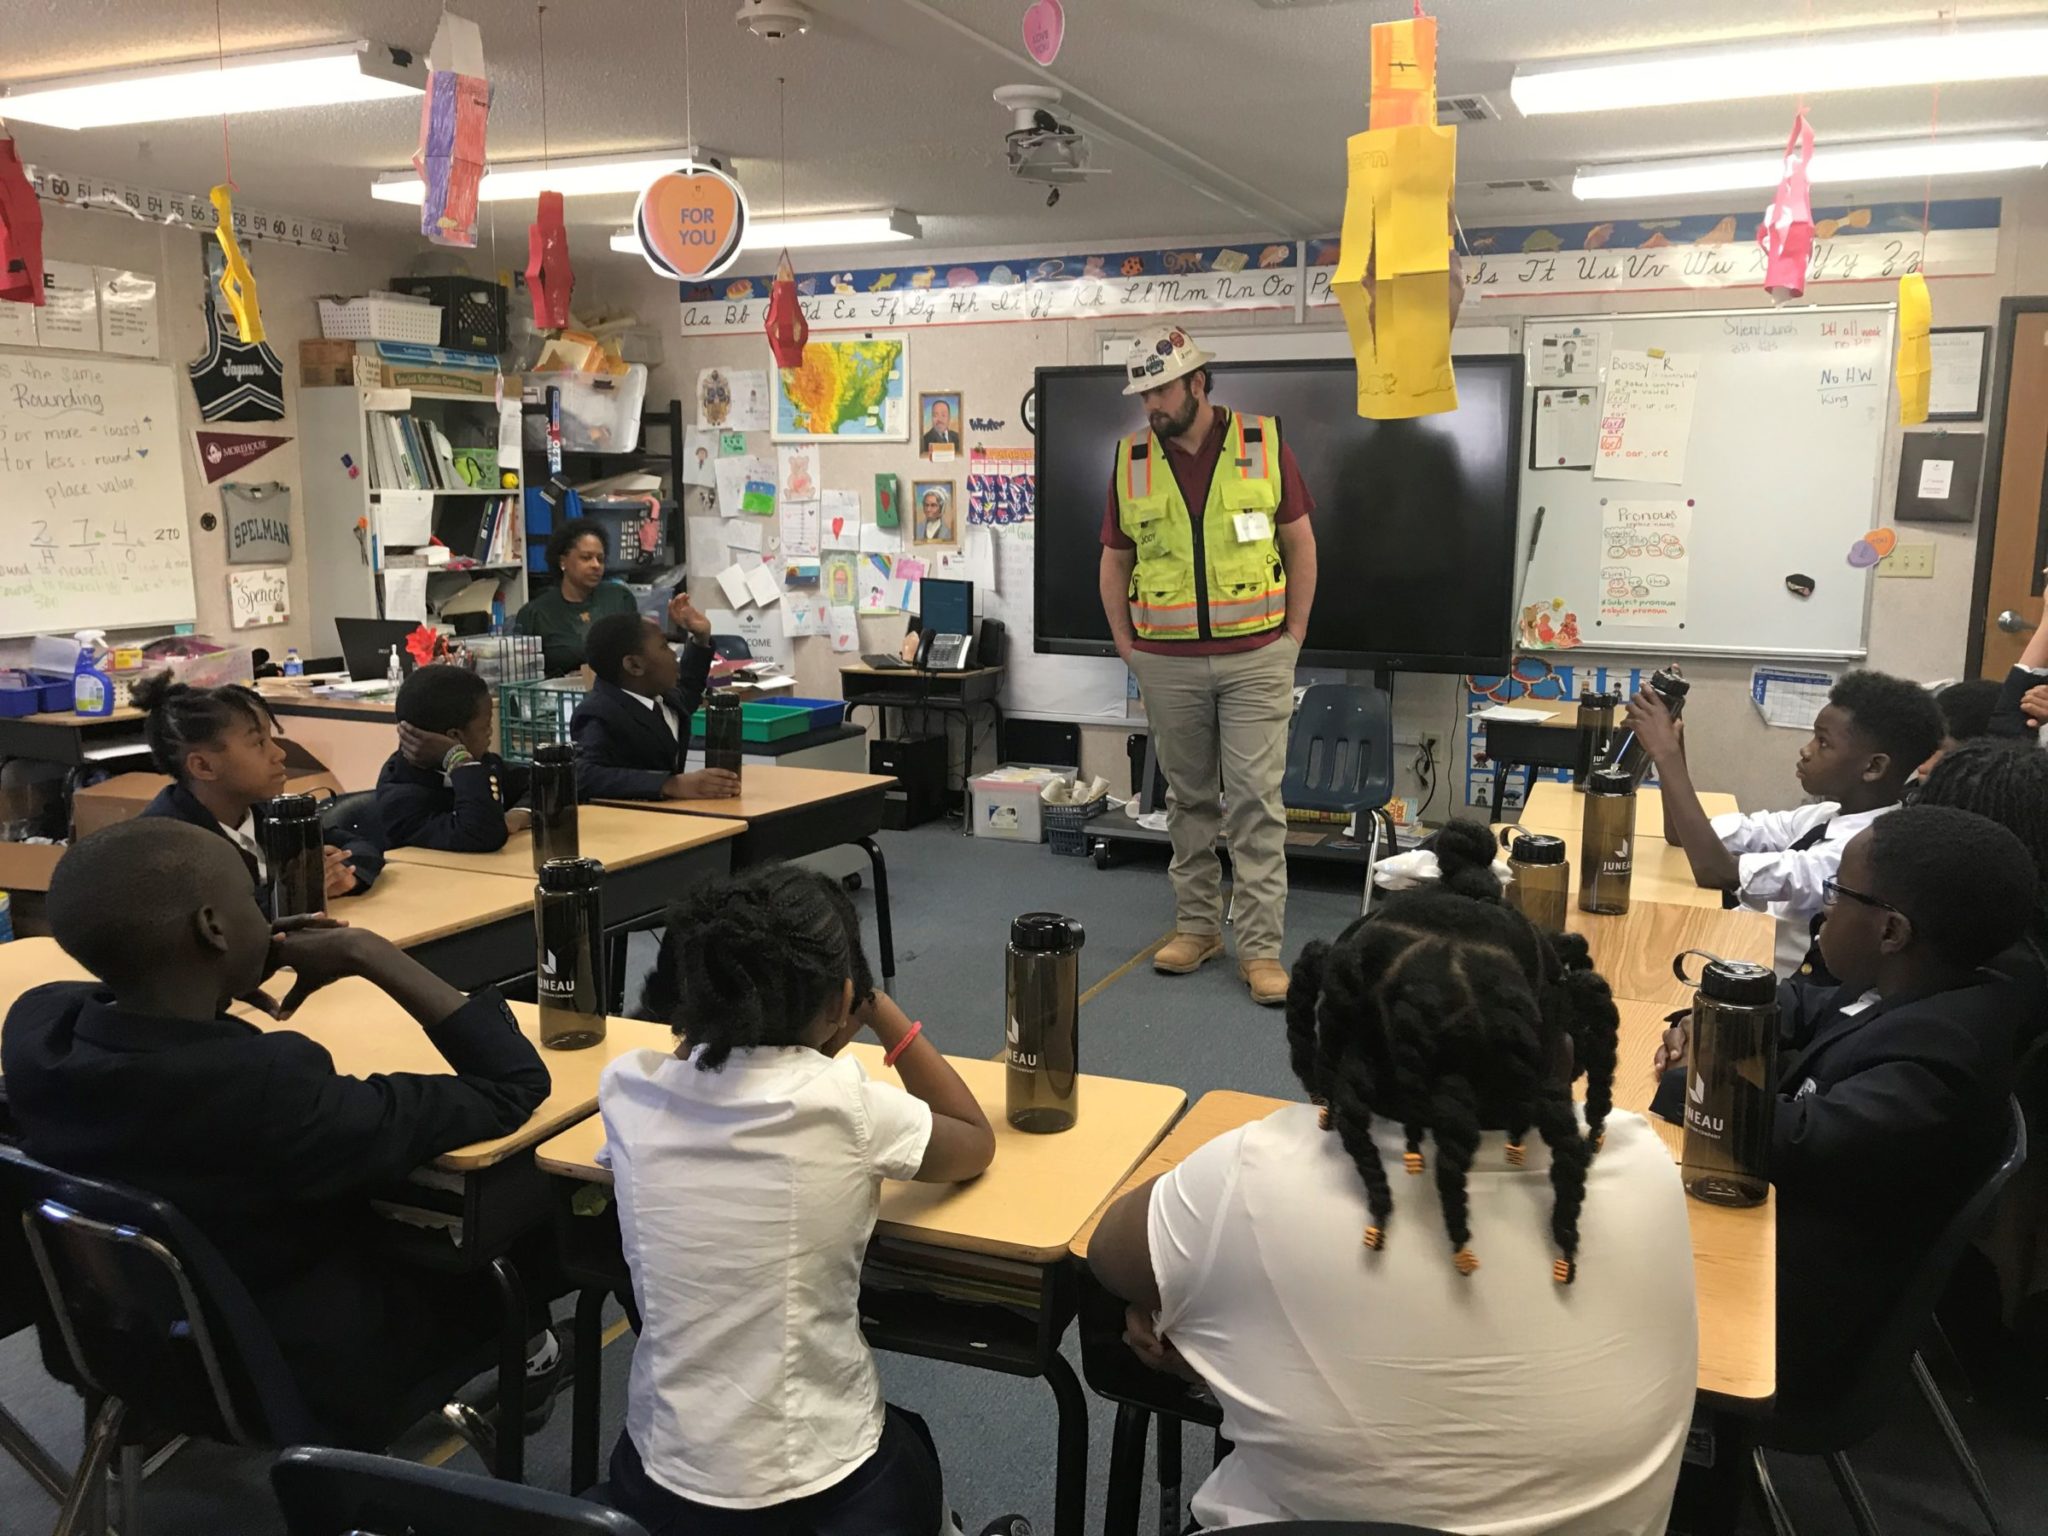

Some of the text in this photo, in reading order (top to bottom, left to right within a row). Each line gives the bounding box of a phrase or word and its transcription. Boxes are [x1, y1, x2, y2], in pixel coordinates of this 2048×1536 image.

[147, 196, 162, 212] 54
[191, 205, 205, 220] 56
[234, 213, 247, 227] 58
[254, 216, 267, 231] 59
[273, 219, 286, 235] 60
[292, 224, 303, 237] 61
[311, 227, 322, 242] 62
[329, 231, 339, 244] 63
[680, 207, 714, 225] FOR
[678, 229, 716, 246] YOU
[684, 307, 711, 326] Aa
[724, 304, 750, 324] Bb
[833, 299, 856, 319] Ee
[871, 297, 900, 325] Ff
[1158, 280, 1209, 301] Mm
[1216, 277, 1255, 299] Nn
[1262, 274, 1295, 296] Oo
[1518, 259, 1557, 282] Tt
[1576, 256, 1619, 280] Uu
[1627, 254, 1669, 279] Vv
[1881, 240, 1923, 276] Zz
[222, 358, 265, 383] Jaguars
[1612, 356, 1674, 378] Bossy R
[1820, 368, 1840, 385] No
[10, 383, 105, 416] Rounding
[1821, 394, 1850, 409] King
[969, 417, 1005, 432] Winter
[45, 427, 82, 441] more
[223, 440, 269, 457] MOREHOUSE
[46, 477, 137, 510] place value
[31, 520, 53, 544] 2
[113, 520, 128, 541] 4
[154, 528, 181, 541] 270
[234, 518, 290, 549] SPELMAN
[746, 638, 772, 648] COME
[1603, 861, 1632, 871] JUNEA
[538, 976, 575, 992] UNEAU
[1007, 1048, 1037, 1067] NEAU
[1687, 1106, 1724, 1132] NEAU
